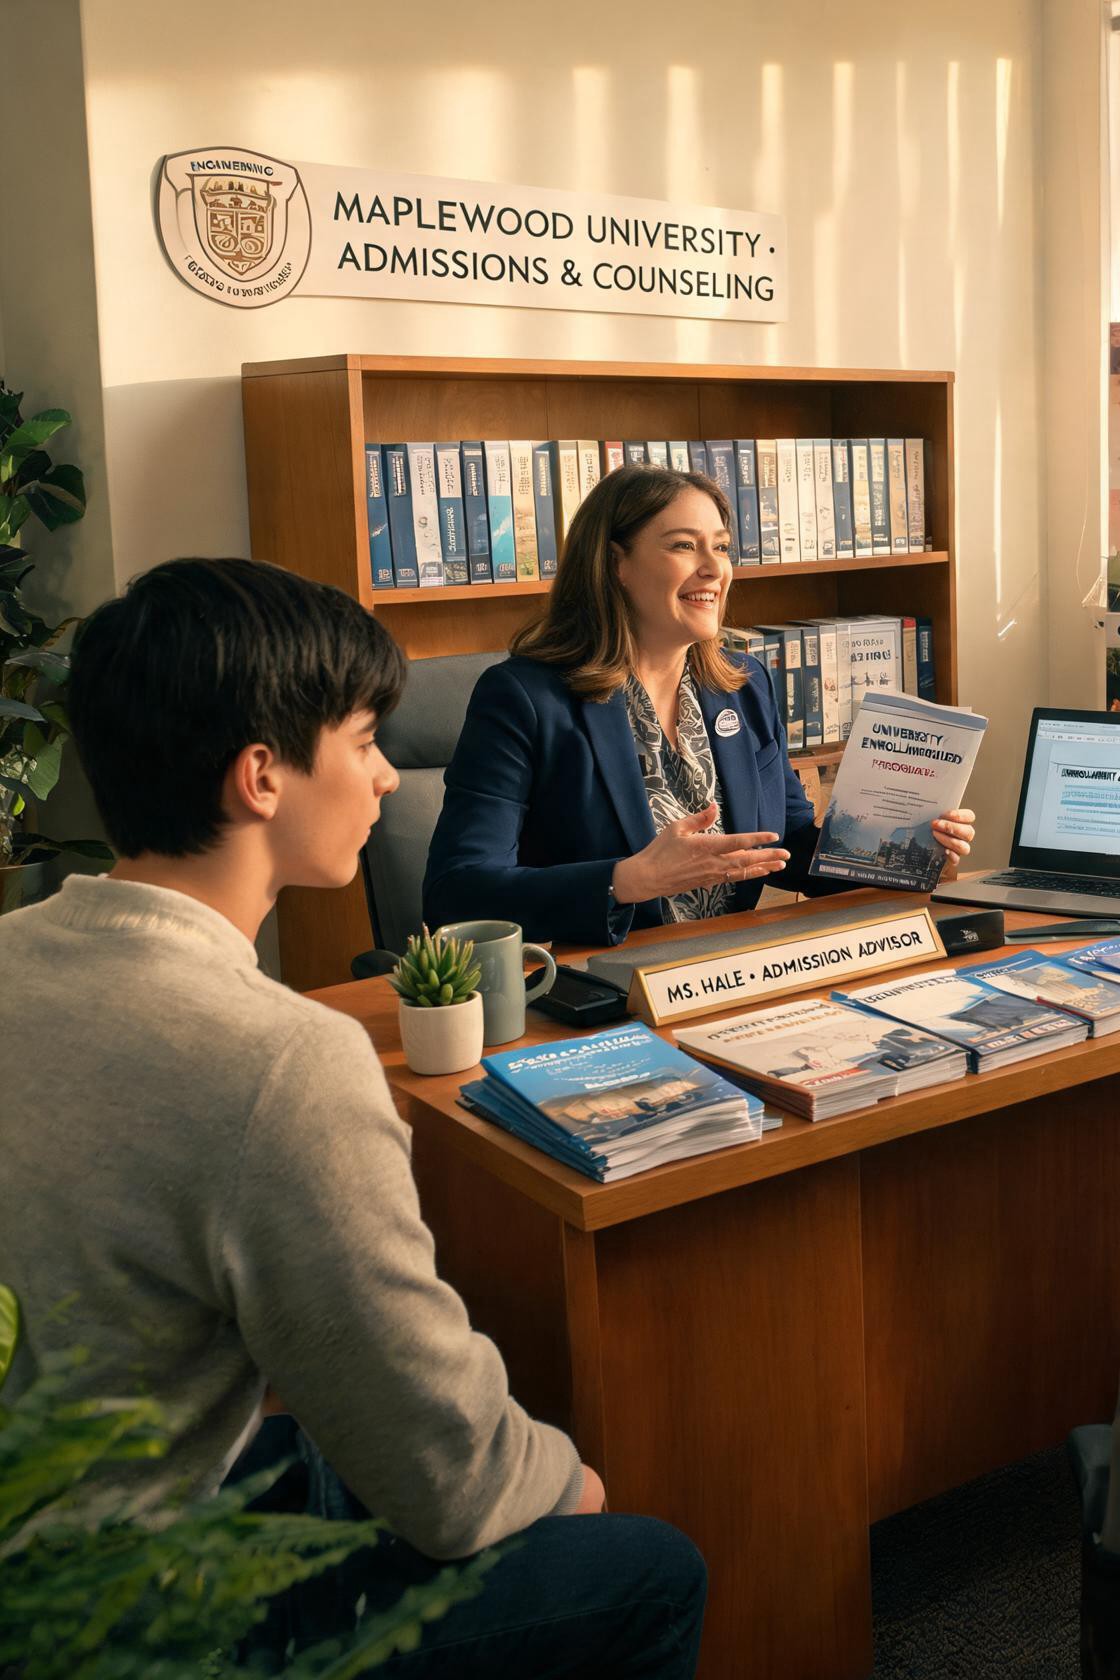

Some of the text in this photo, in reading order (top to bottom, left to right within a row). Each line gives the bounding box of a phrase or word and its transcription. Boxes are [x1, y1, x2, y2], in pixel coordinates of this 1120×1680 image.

[333, 191, 574, 240] MAPLEWOOD
[587, 214, 761, 258] UNIVERSITY
[337, 241, 549, 285] ADMISSIONS
[560, 258, 583, 287] &
[593, 262, 774, 301] COUNSELING
[667, 983, 699, 1003] MS.
[701, 970, 745, 995] HALE
[859, 930, 923, 958] ADVISOR
